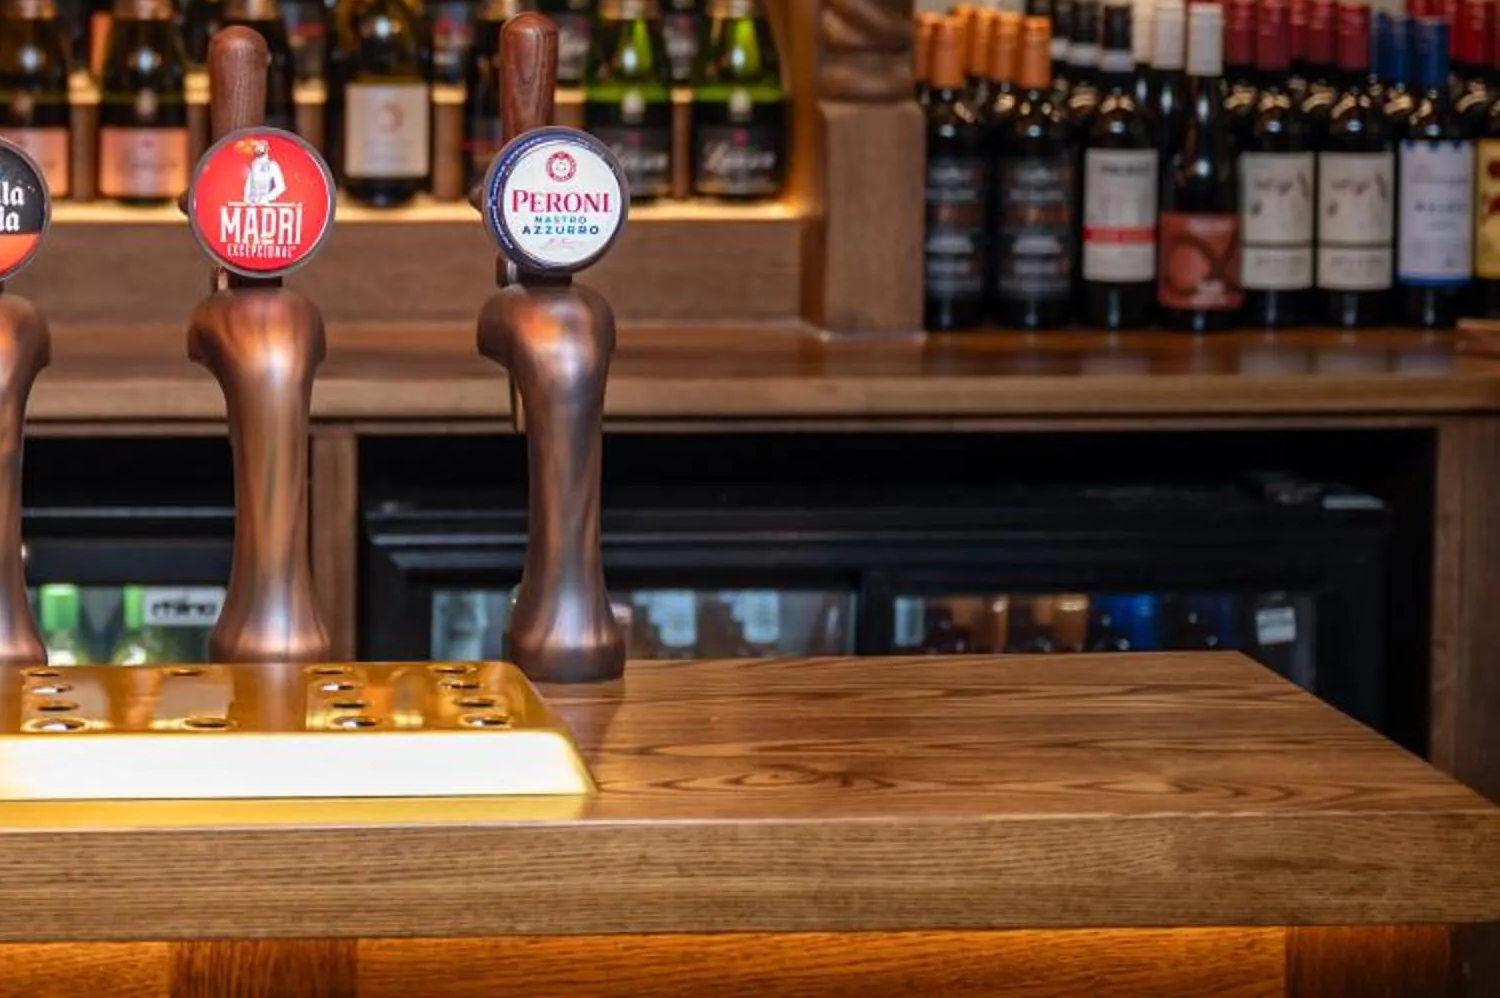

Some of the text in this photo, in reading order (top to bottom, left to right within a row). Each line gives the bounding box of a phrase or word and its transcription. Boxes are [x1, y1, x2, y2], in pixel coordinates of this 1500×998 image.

[511, 189, 613, 214] PERONI
[533, 216, 588, 225] NASTRO
[521, 225, 600, 236] AZZURRO
